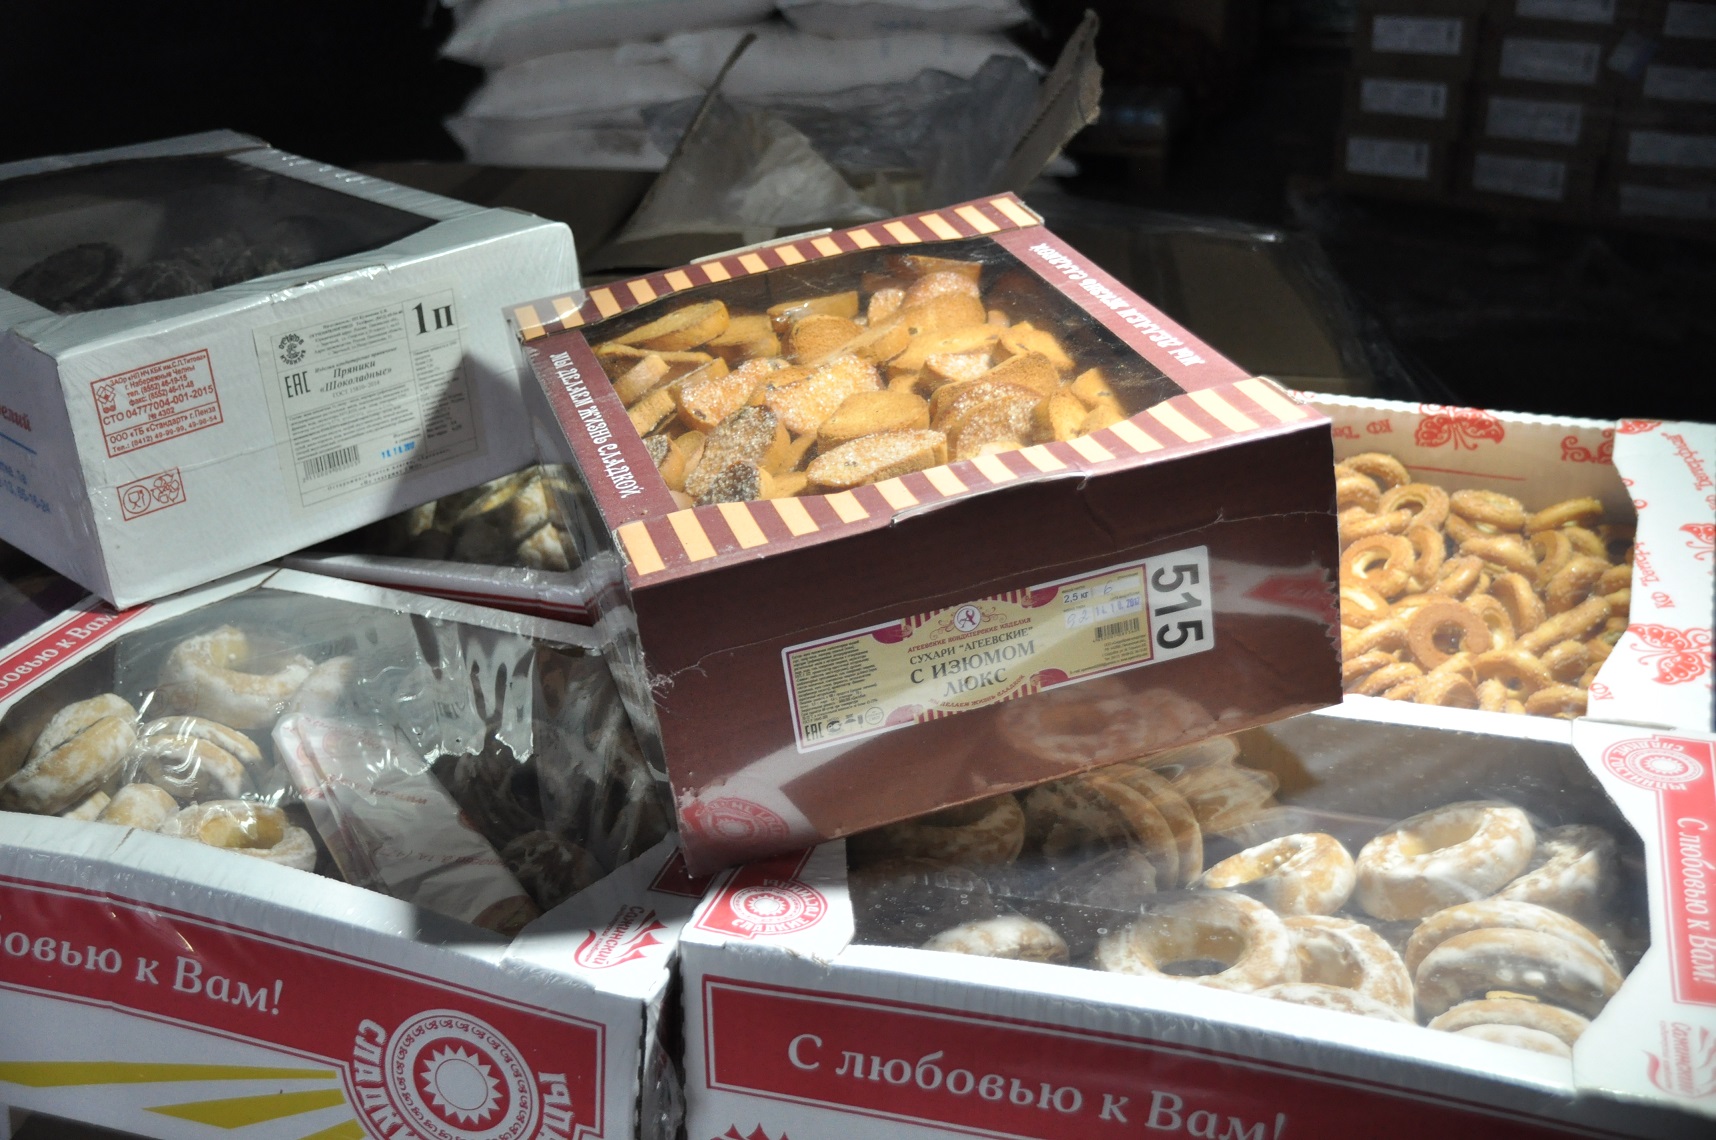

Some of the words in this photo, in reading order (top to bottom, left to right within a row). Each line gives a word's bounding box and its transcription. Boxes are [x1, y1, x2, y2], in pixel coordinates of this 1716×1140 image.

[1029, 242, 1088, 280] СЛАДКОЙ
[1079, 278, 1130, 311] ЖИЗНЬ
[1117, 308, 1184, 348] ДЕЛАЕМ
[333, 359, 376, 380] Пряники
[549, 351, 574, 369] МЫ
[1168, 347, 1206, 366] МЫ
[130, 372, 172, 389] Набережные
[172, 365, 196, 376] Челны
[319, 367, 392, 393] «Шоколадные»
[557, 367, 594, 408] ДЕЛАЕМ
[103, 411, 124, 426] СТО
[110, 431, 128, 444] ООО
[146, 415, 188, 433] «Стандарт»
[577, 405, 613, 445] ЖИЗНЬ
[597, 443, 645, 499] СЛАДКОЙ
[1064, 593, 1078, 603] 2,5
[1081, 591, 1089, 599] кг
[1651, 591, 1676, 609] КФ
[56, 638, 76, 649] к
[907, 638, 946, 653] АГЕЕВСКИЕ
[948, 626, 998, 643] КОНДИТЕРСКИЕ
[1000, 617, 1031, 629] ИЗДЕЛИЯ
[909, 647, 955, 665] СУХАРИ
[910, 669, 925, 684] С
[931, 640, 1035, 680] ИЗЮМОМ
[943, 668, 1008, 697] ЛЮКС
[971, 695, 996, 707] ЖИЗНЬ
[1611, 740, 1684, 759] СЛАДКИЕ
[1610, 756, 1687, 791] ГОСТИНЦЫ
[1677, 817, 1708, 831] С
[1678, 831, 1716, 915] любовью
[763, 879, 819, 917] ГОСТИНЦЫ
[731, 917, 810, 932] СЛАДКИЕ
[1687, 918, 1711, 931] к
[0, 931, 122, 973] овью
[135, 957, 160, 985] к
[173, 955, 283, 1015] Вам!
[788, 1032, 823, 1071] С
[835, 1049, 1083, 1113] любовью
[1098, 1092, 1129, 1123] к
[1145, 1090, 1286, 1140] Вам!
